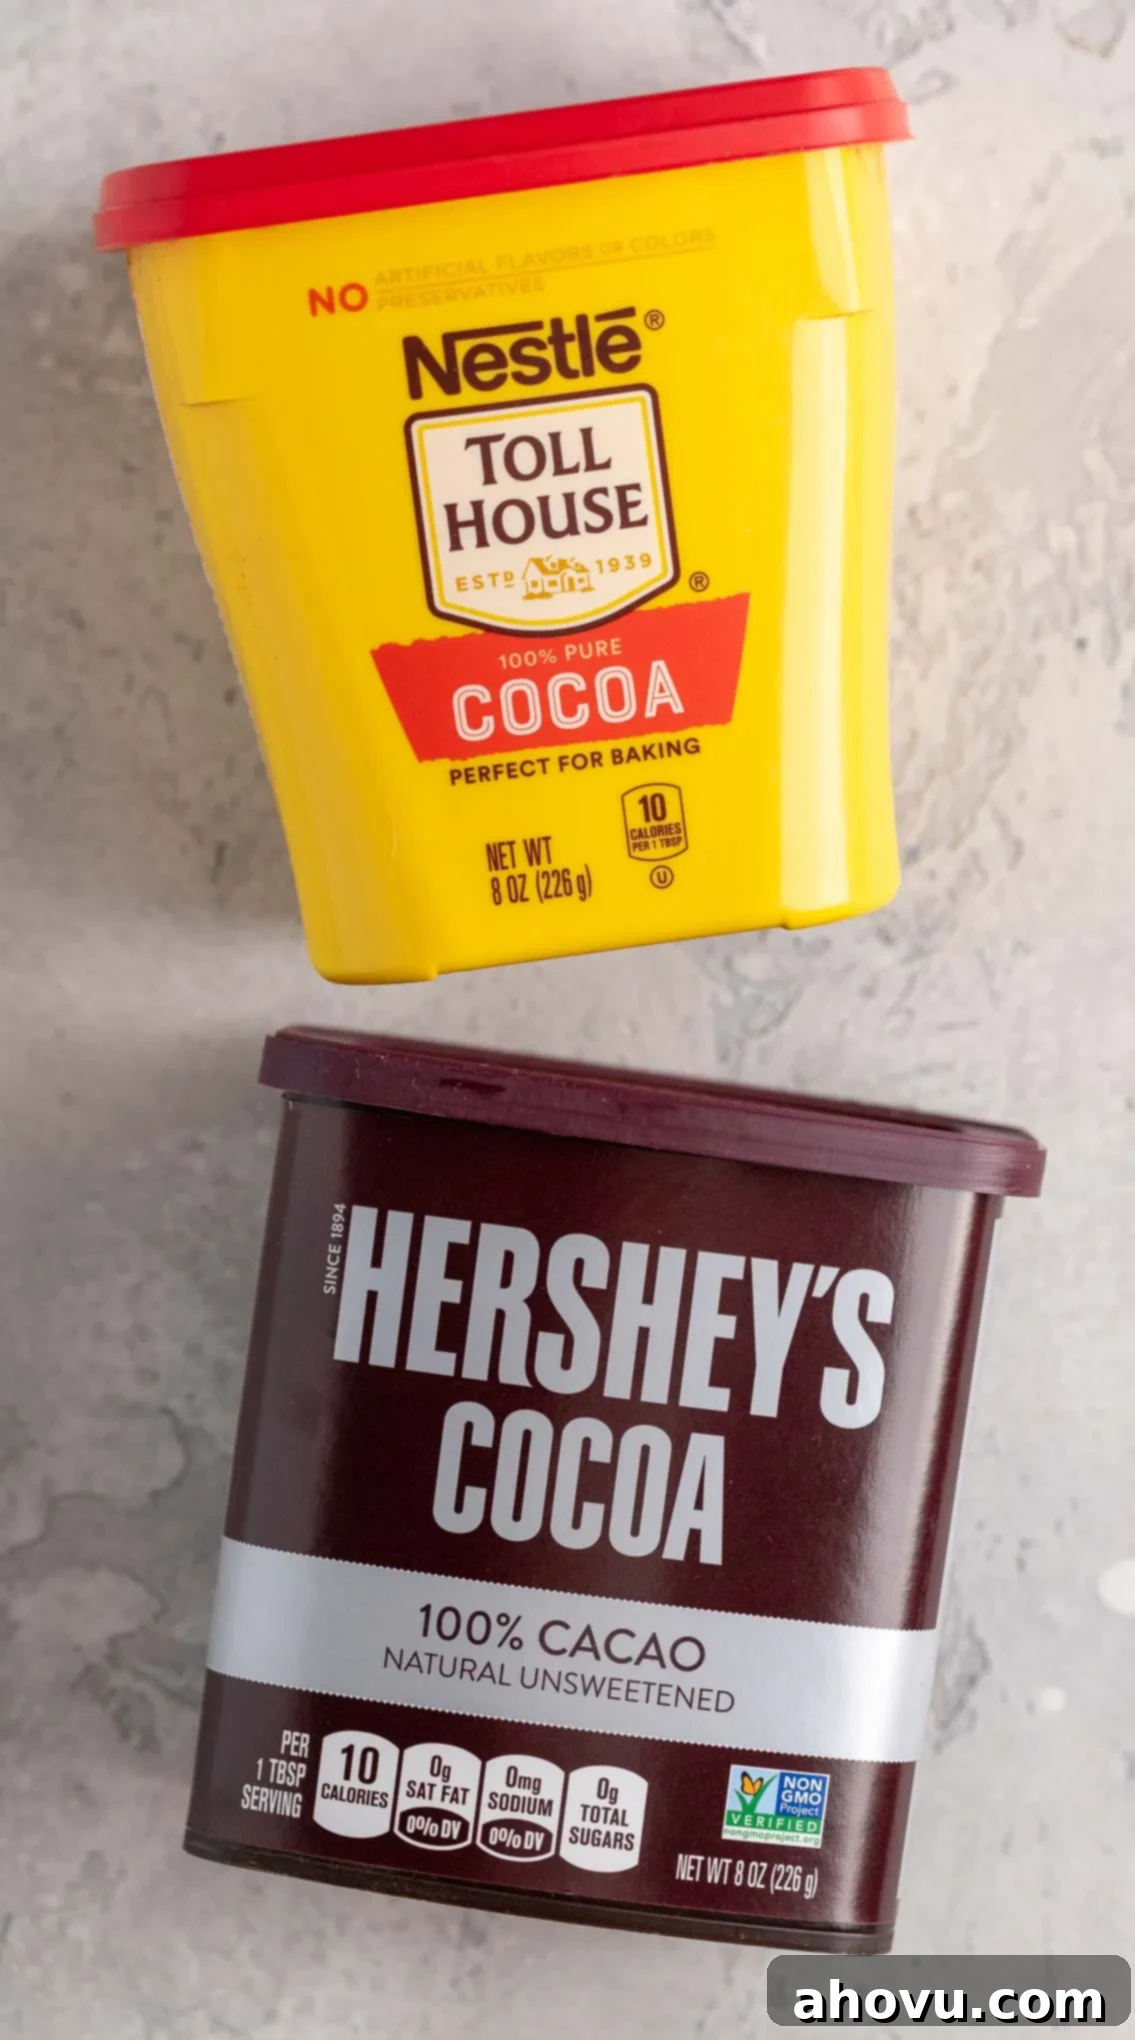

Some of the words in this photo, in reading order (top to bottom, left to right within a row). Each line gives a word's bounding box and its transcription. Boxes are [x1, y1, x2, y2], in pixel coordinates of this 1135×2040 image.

[374, 259, 487, 287] ARTIFICIAL
[496, 244, 592, 272] FLAVORS
[631, 227, 717, 254] COLORS
[308, 282, 369, 318] NO
[376, 275, 546, 313] PRESERVATIVES
[464, 427, 612, 486] TOLL
[443, 483, 649, 552] HOUSE
[595, 552, 652, 575] 1939
[498, 647, 557, 671] 100%
[564, 638, 623, 662] PURE
[452, 659, 685, 742] COCOA
[449, 757, 551, 786] PERFECT
[558, 751, 604, 774] FOR
[611, 738, 701, 766] BAKING
[638, 792, 667, 823] 10
[630, 822, 682, 841] CALORIES
[632, 840, 650, 853] PER
[660, 836, 683, 849] TBSP
[485, 841, 517, 872] NET
[523, 836, 552, 868] WT
[491, 877, 502, 906] 8
[506, 873, 530, 904] OZ
[536, 867, 573, 904] (226
[576, 863, 593, 903] g)
[330, 1202, 347, 1240] 1894
[323, 1242, 344, 1296] SINCE
[333, 1204, 895, 1430] HERSHEY'S
[432, 1401, 726, 1566] COCOA
[419, 1603, 524, 1651] 100%
[538, 1619, 706, 1673] CACAO
[383, 1646, 512, 1687] NATURAL
[519, 1666, 735, 1713] UNSWEETENED
[281, 1729, 310, 1759] PER
[256, 1758, 263, 1782] 1
[268, 1758, 307, 1788] TBSP
[340, 1744, 380, 1785] 10
[429, 1754, 452, 1783] 0g
[405, 1780, 437, 1802] SAT
[440, 1784, 470, 1806] FAT
[505, 1765, 542, 1795] 0mg
[596, 1776, 619, 1805] 0g
[783, 1775, 823, 1791] NON
[240, 1783, 303, 1818] SERVING
[320, 1782, 389, 1809] CALORIES
[488, 1791, 554, 1818] SODIUM
[780, 1802, 819, 1817] Project
[781, 1789, 822, 1806] GMO
[406, 1814, 439, 1838] 0%
[440, 1819, 462, 1841] DV
[580, 1803, 630, 1828] TOTAL
[731, 1812, 818, 1833] VERIFIED
[488, 1826, 522, 1850] 0%
[523, 1831, 545, 1852] DV
[568, 1826, 635, 1852] SUGARS
[723, 1828, 821, 1846] nongmoproject.org
[676, 1853, 704, 1881] NET
[706, 1856, 732, 1884] WT
[734, 1859, 744, 1887] 8
[747, 1861, 768, 1890] OZ
[770, 1863, 802, 1894] (226
[804, 1866, 819, 1899] g)
